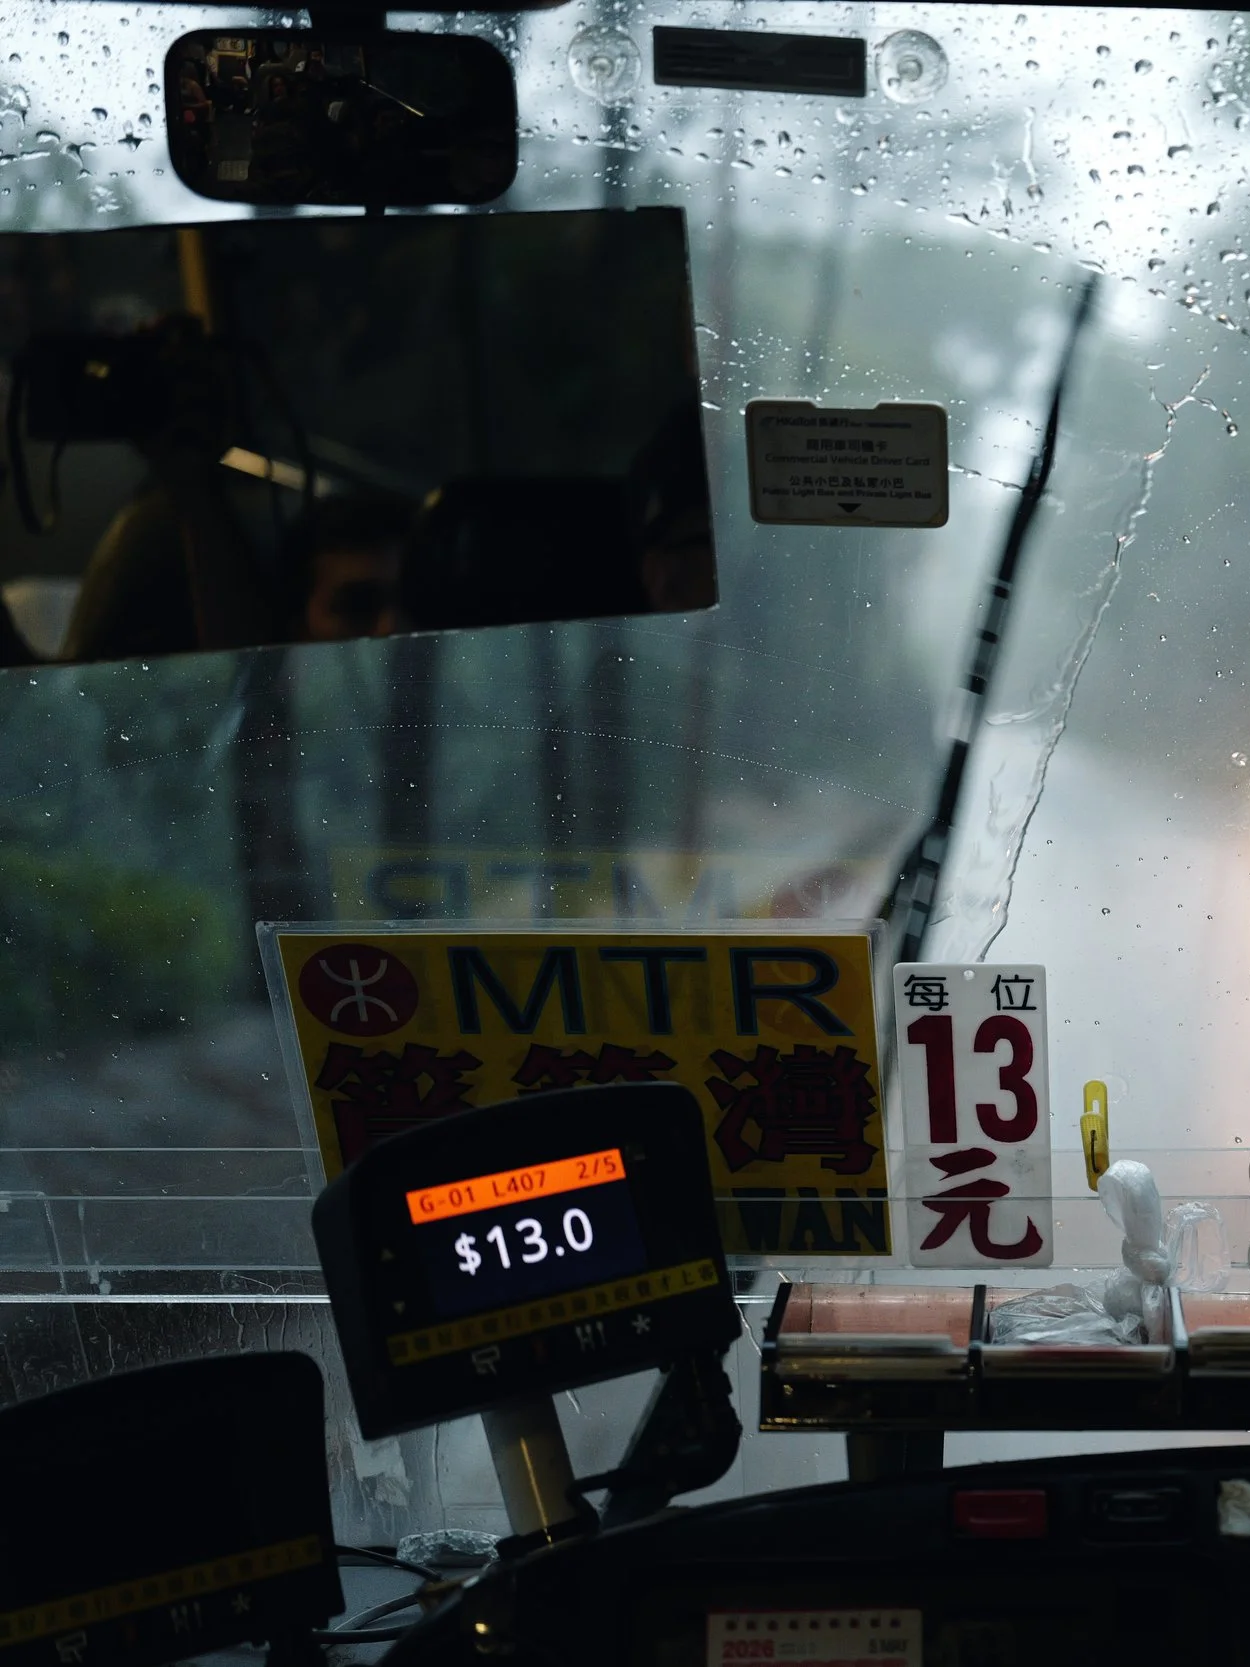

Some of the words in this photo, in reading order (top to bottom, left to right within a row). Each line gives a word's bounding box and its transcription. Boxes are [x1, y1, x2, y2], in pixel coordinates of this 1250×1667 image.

[765, 453, 828, 464] Commercial
[831, 455, 869, 465] Vehicle
[871, 456, 903, 466] Driver
[905, 456, 931, 466] Card
[789, 475, 905, 489] 公共小巴及私家小巴
[762, 486, 791, 496] Public
[792, 487, 816, 497] Light
[817, 488, 835, 497] Bus
[837, 488, 854, 497] and
[856, 488, 887, 498] Private
[890, 489, 912, 499] Light
[914, 490, 932, 499] Bus
[446, 946, 857, 1036] MTR
[907, 1014, 1039, 1144] 13
[419, 1186, 476, 1215] G-01
[491, 1169, 547, 1199] L407
[575, 1154, 617, 1180] 2/5
[920, 1147, 1044, 1260] 元
[453, 1207, 595, 1277] $13.0
[732, 1186, 888, 1252] WAN
[722, 1639, 775, 1659] 2026
